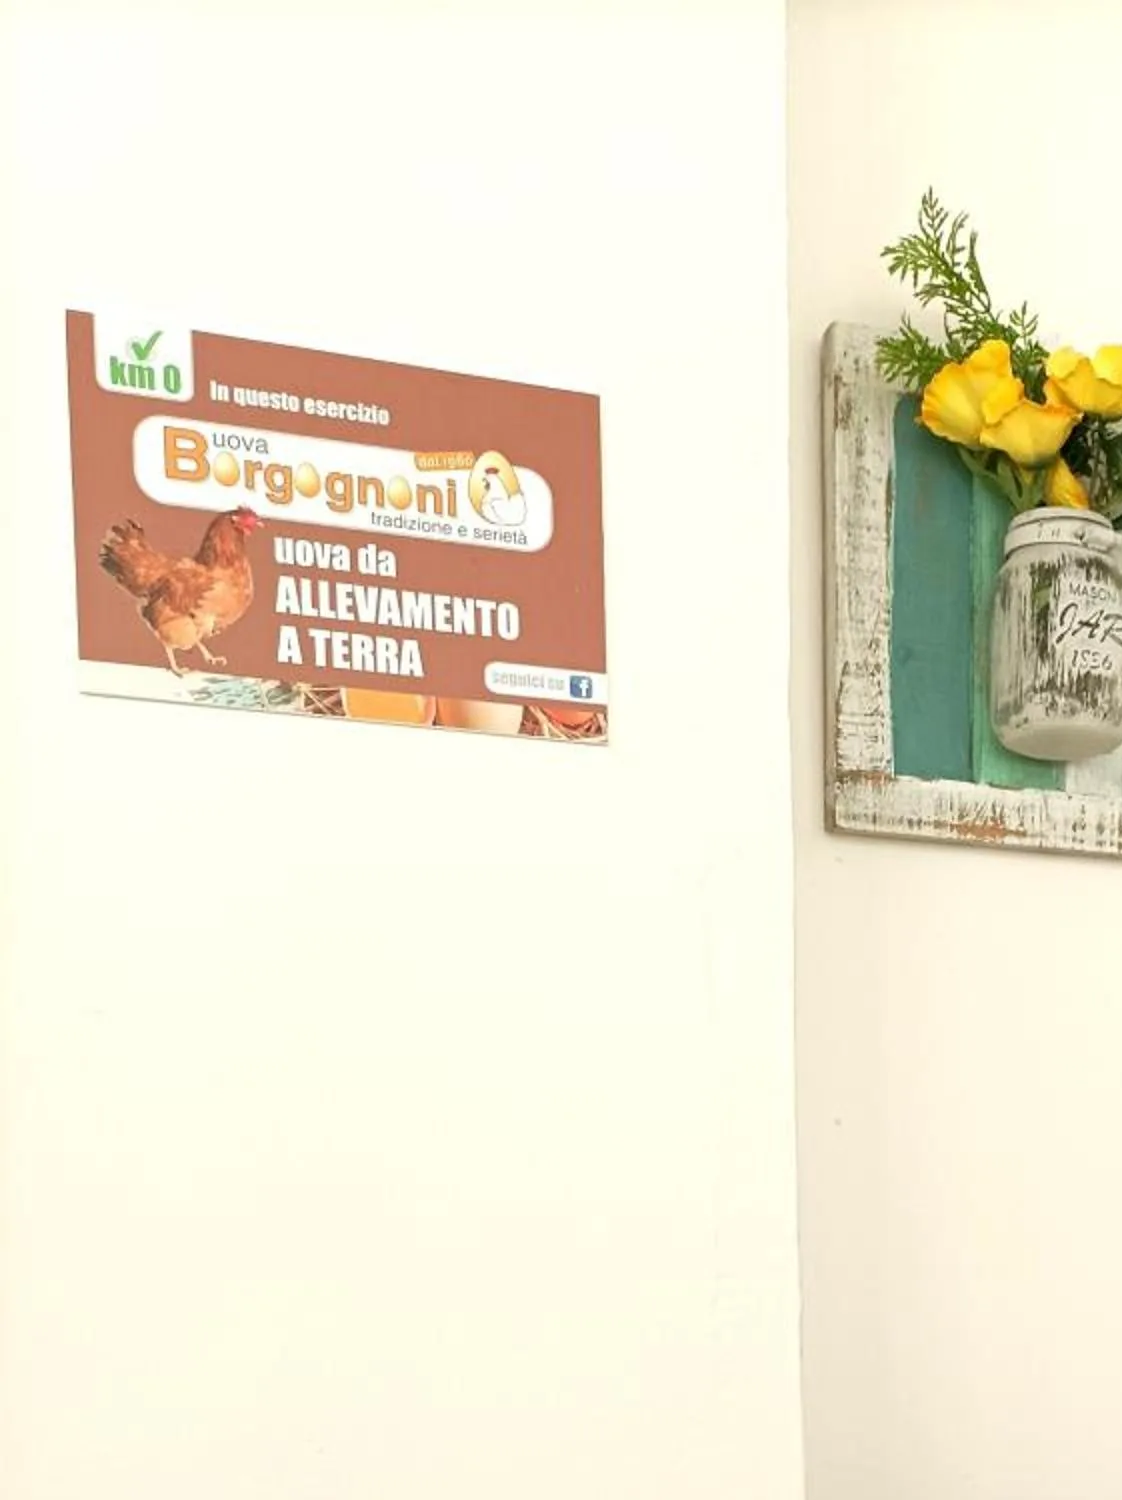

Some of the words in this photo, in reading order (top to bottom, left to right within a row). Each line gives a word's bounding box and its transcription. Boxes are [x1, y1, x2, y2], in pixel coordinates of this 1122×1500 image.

[110, 356, 155, 390] km
[163, 364, 181, 393] 0
[210, 380, 229, 401] In
[234, 386, 299, 412] questo
[304, 398, 390, 425] esercizio
[371, 511, 453, 535] tradizione
[457, 525, 468, 537] e
[473, 527, 528, 545] serietà
[273, 537, 350, 572] uova
[357, 543, 397, 578] da
[275, 574, 520, 641] ALLEVAMENTO
[277, 625, 302, 664] A
[307, 627, 425, 678] TERRA
